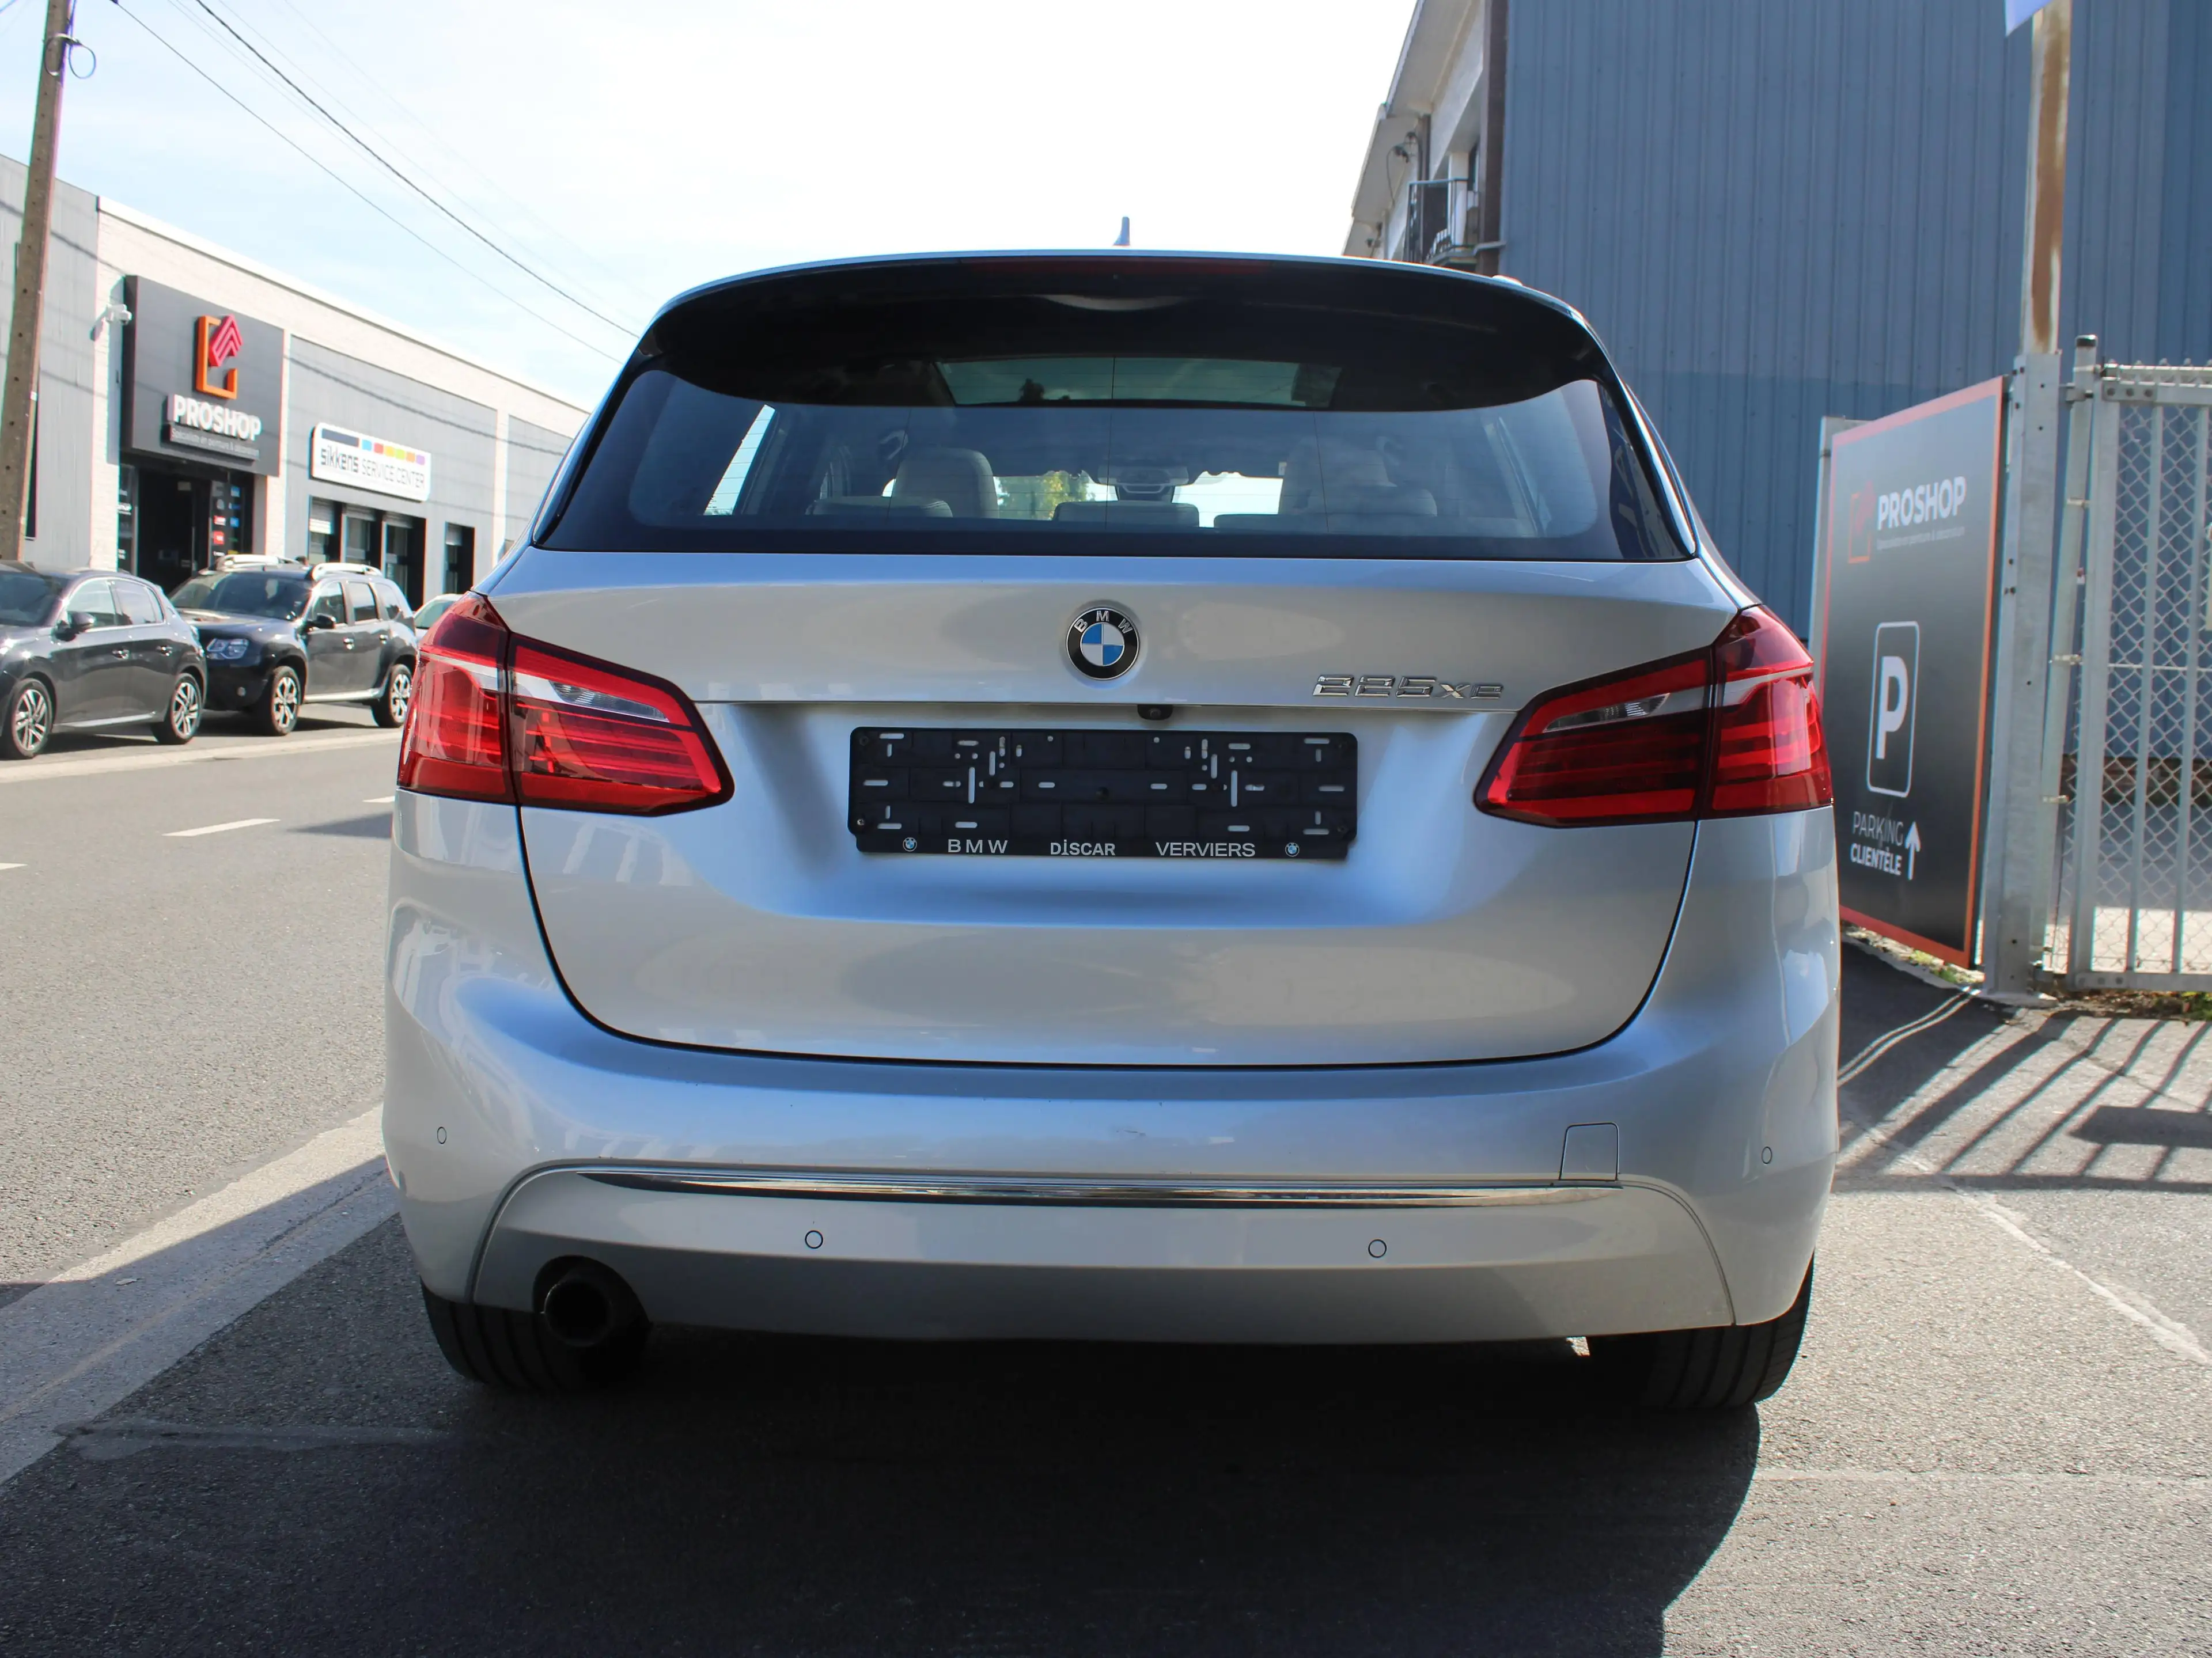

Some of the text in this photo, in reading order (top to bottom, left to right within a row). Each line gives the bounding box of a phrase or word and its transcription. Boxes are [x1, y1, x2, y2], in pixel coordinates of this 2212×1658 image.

[173, 394, 262, 441] PROSHOP
[321, 445, 425, 488] sikkens SERVICE CENTER
[1877, 476, 1966, 530] PROSHOP
[1074, 610, 1132, 633] BMW
[1876, 656, 1908, 760] P
[948, 839, 1008, 853] BMW
[1156, 842, 1256, 857] VERVIERS
[1853, 811, 1903, 846] PARKING
[1850, 843, 1902, 875] CLIENTÈLE
